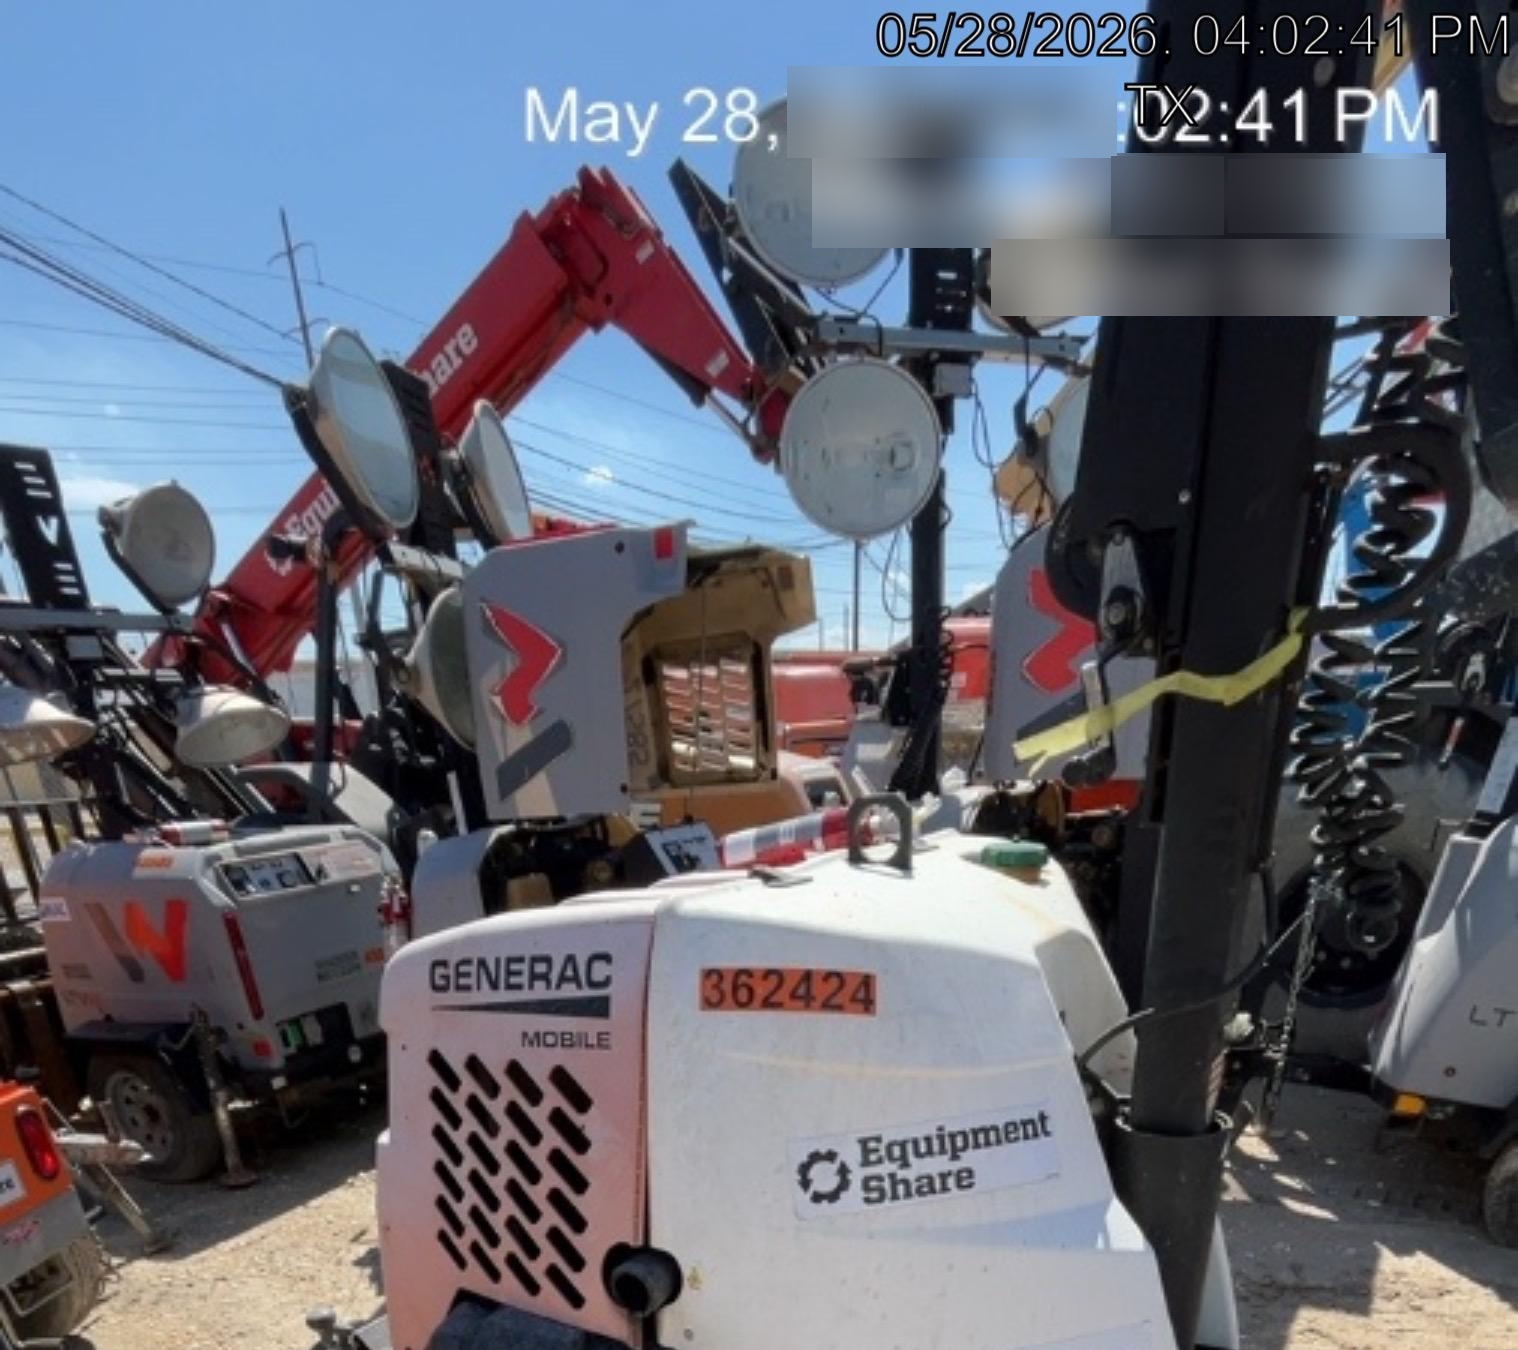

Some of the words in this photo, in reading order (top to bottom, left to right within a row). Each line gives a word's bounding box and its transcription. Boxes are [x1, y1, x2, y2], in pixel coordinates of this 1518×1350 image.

[428, 952, 613, 993] GENERAC
[702, 968, 876, 1013] 362424
[520, 1030, 612, 1051] MOBILE
[857, 1110, 1053, 1170] Equipment
[860, 1166, 976, 1205] Share
